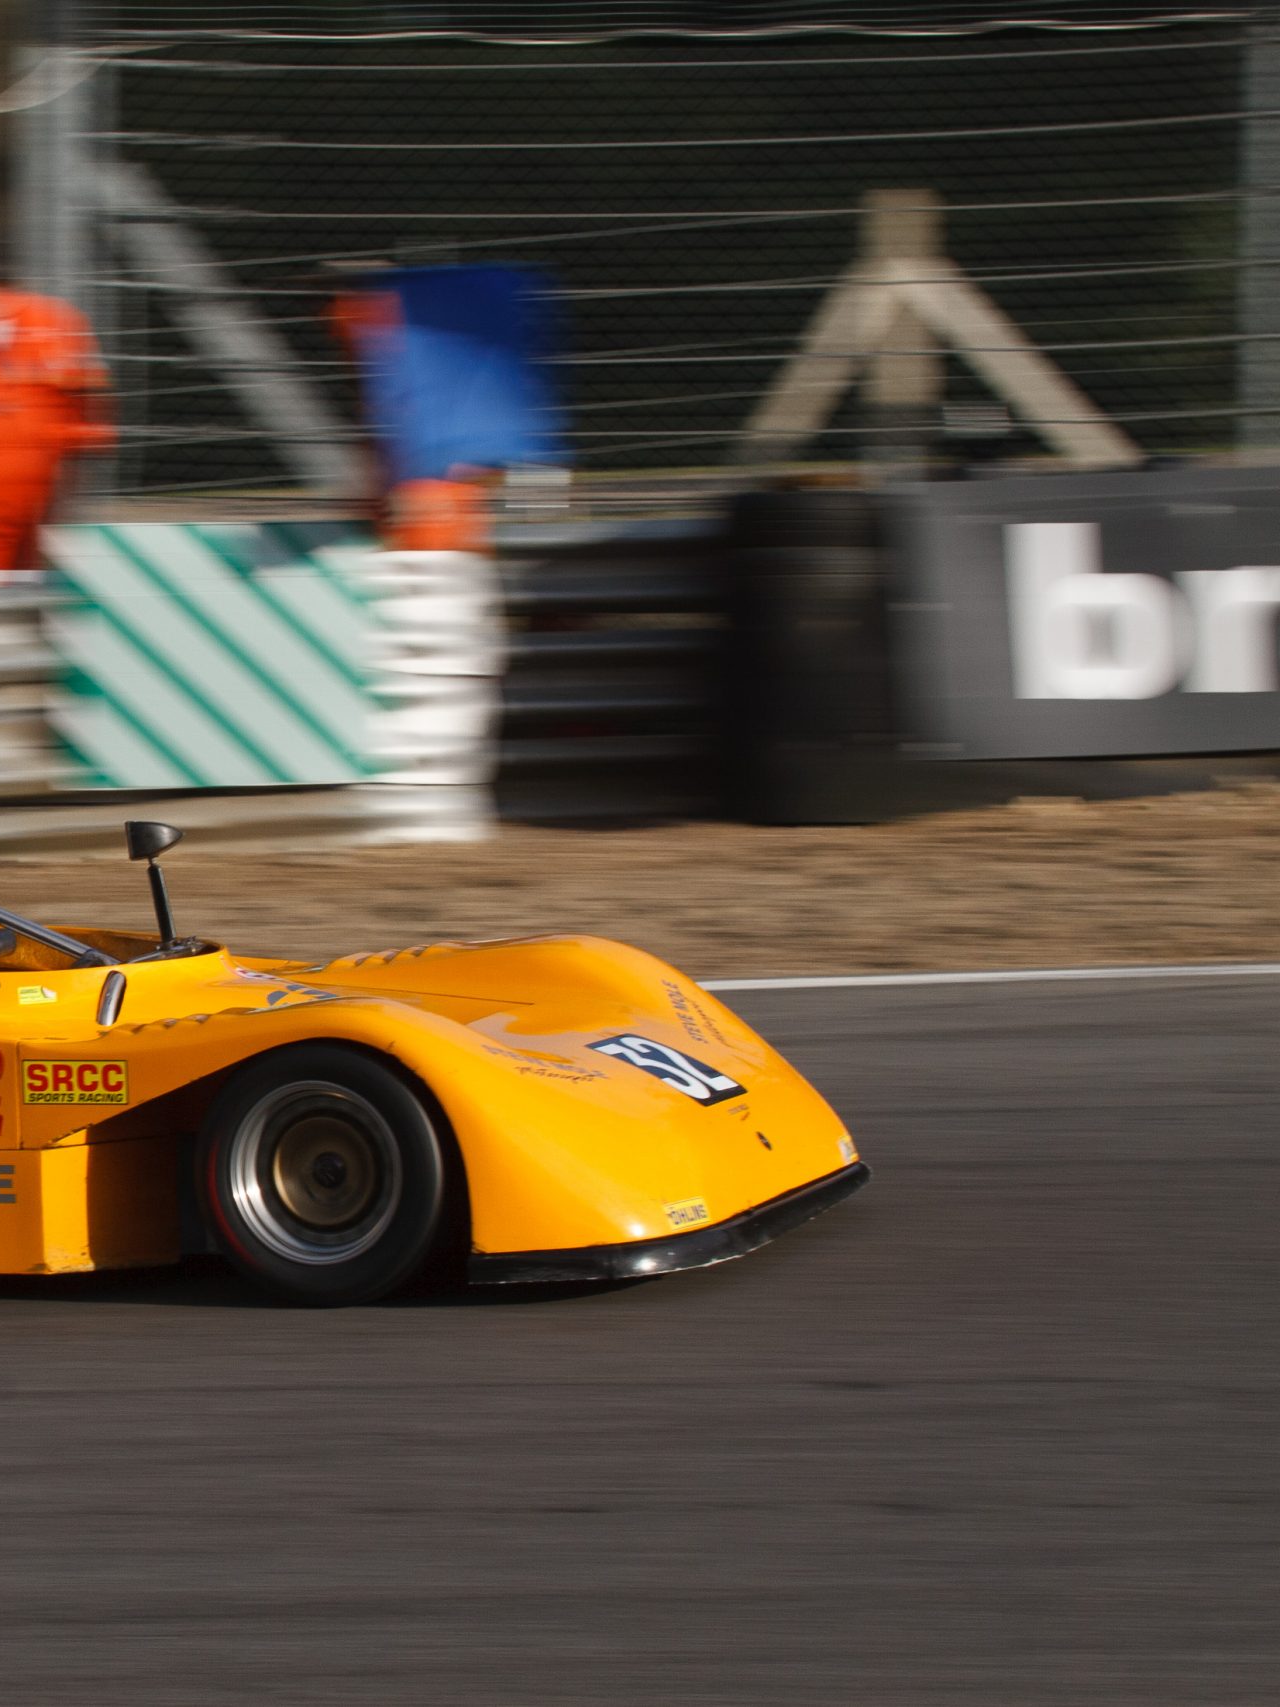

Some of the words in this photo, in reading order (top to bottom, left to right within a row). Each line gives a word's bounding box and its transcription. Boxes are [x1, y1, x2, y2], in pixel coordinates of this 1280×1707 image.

[26, 1064, 124, 1092] SRCC
[594, 1036, 739, 1099] 32
[28, 1093, 74, 1103] SPORTS
[77, 1093, 124, 1103] RACING
